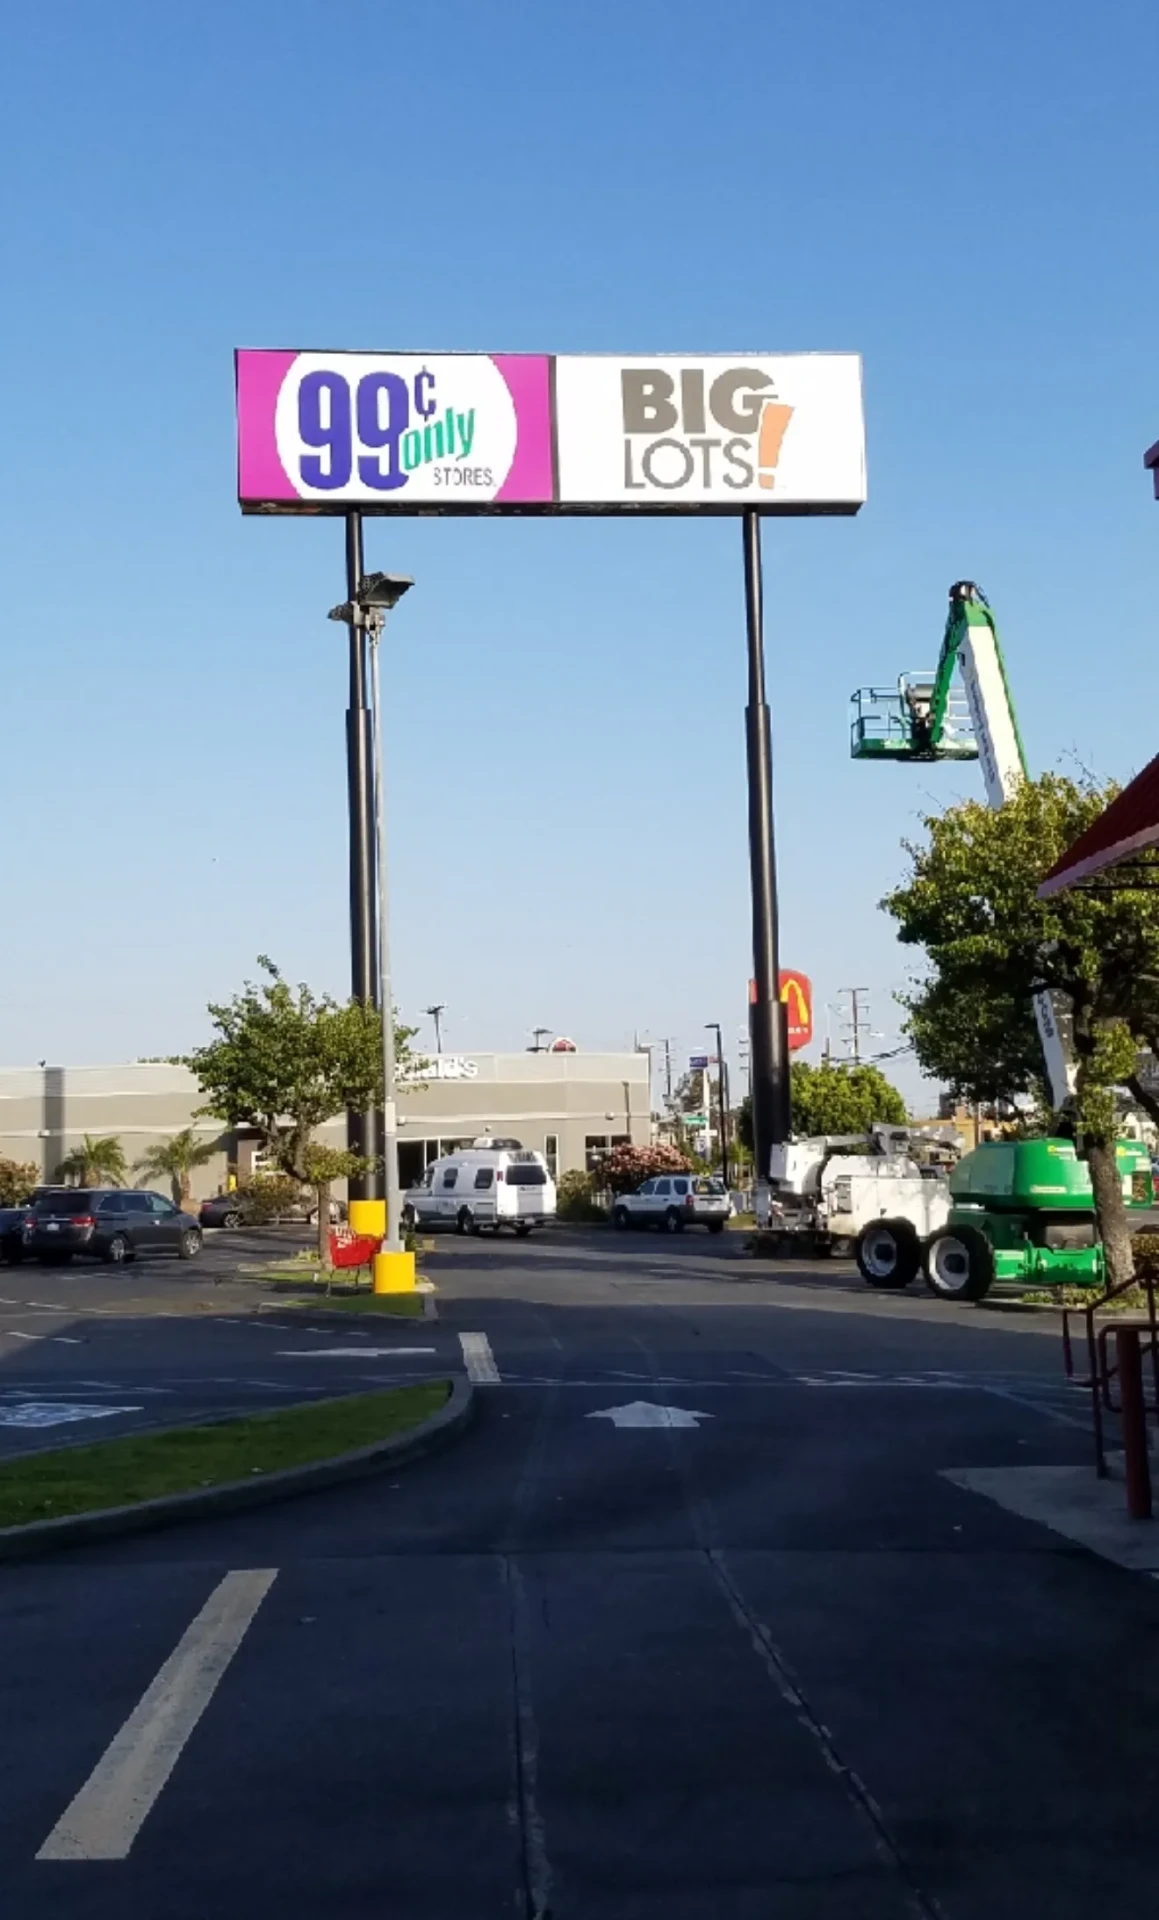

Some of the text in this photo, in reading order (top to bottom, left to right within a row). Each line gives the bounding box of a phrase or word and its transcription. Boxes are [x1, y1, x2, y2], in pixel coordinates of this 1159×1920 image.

[621, 367, 779, 434] BIG
[403, 407, 475, 471] only
[624, 402, 794, 490] LOTS!
